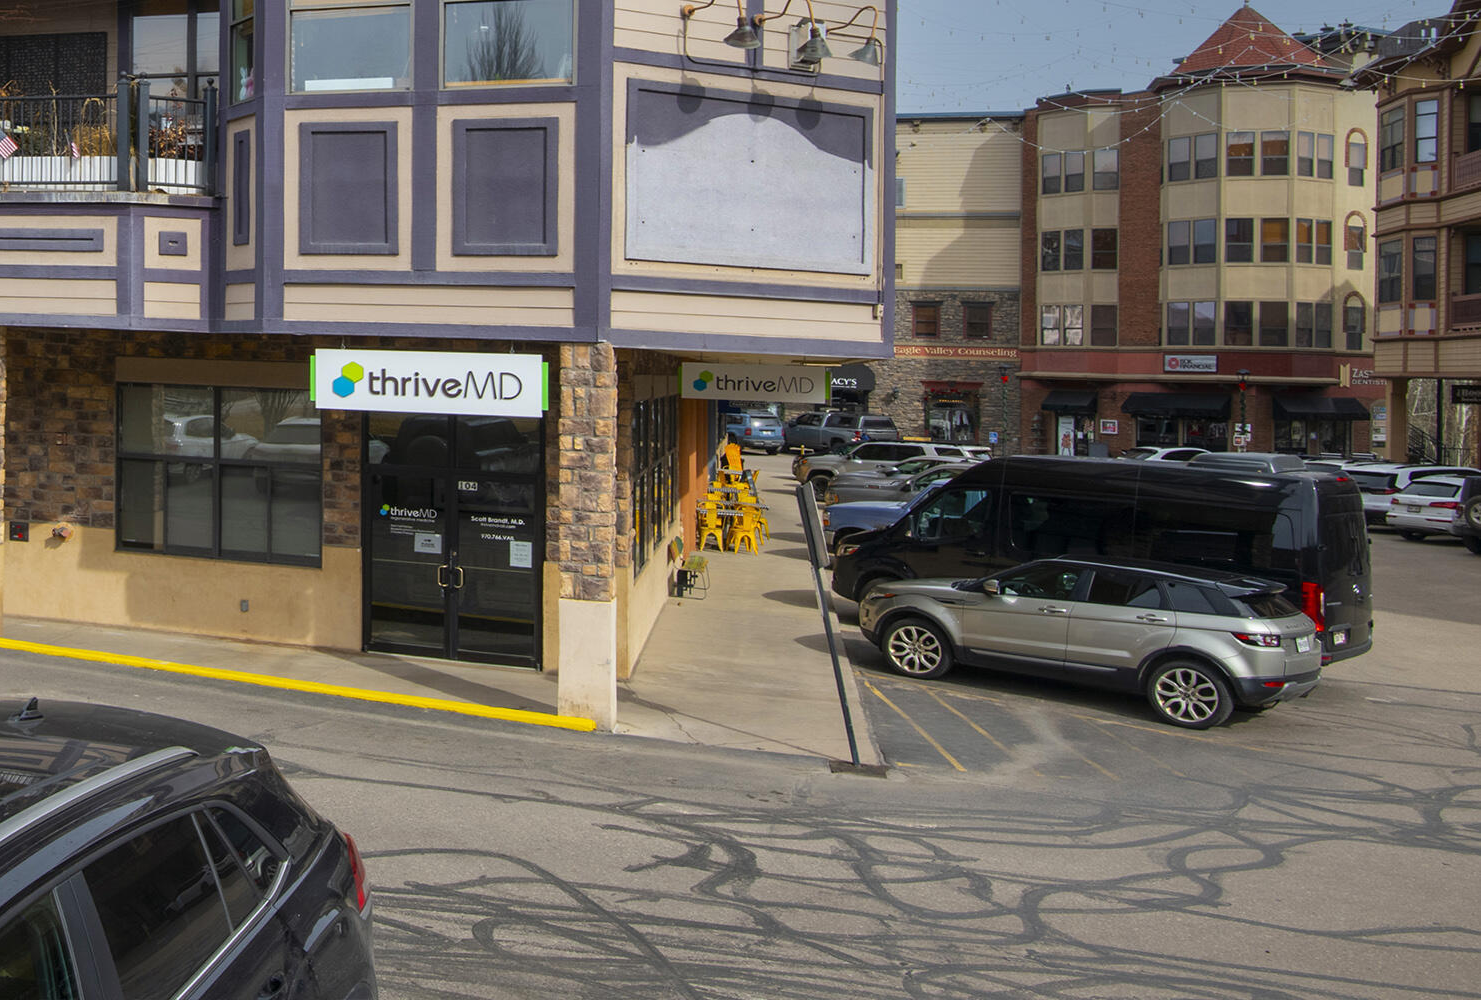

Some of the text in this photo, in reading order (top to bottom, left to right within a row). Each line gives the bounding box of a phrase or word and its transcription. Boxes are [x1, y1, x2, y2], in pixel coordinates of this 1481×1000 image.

[894, 346, 1017, 357] Eagle Valley Counseling
[369, 368, 523, 400] thriveMD
[716, 375, 814, 394] thriveMD
[459, 481, 478, 491] 104
[390, 506, 438, 519] thriveMD
